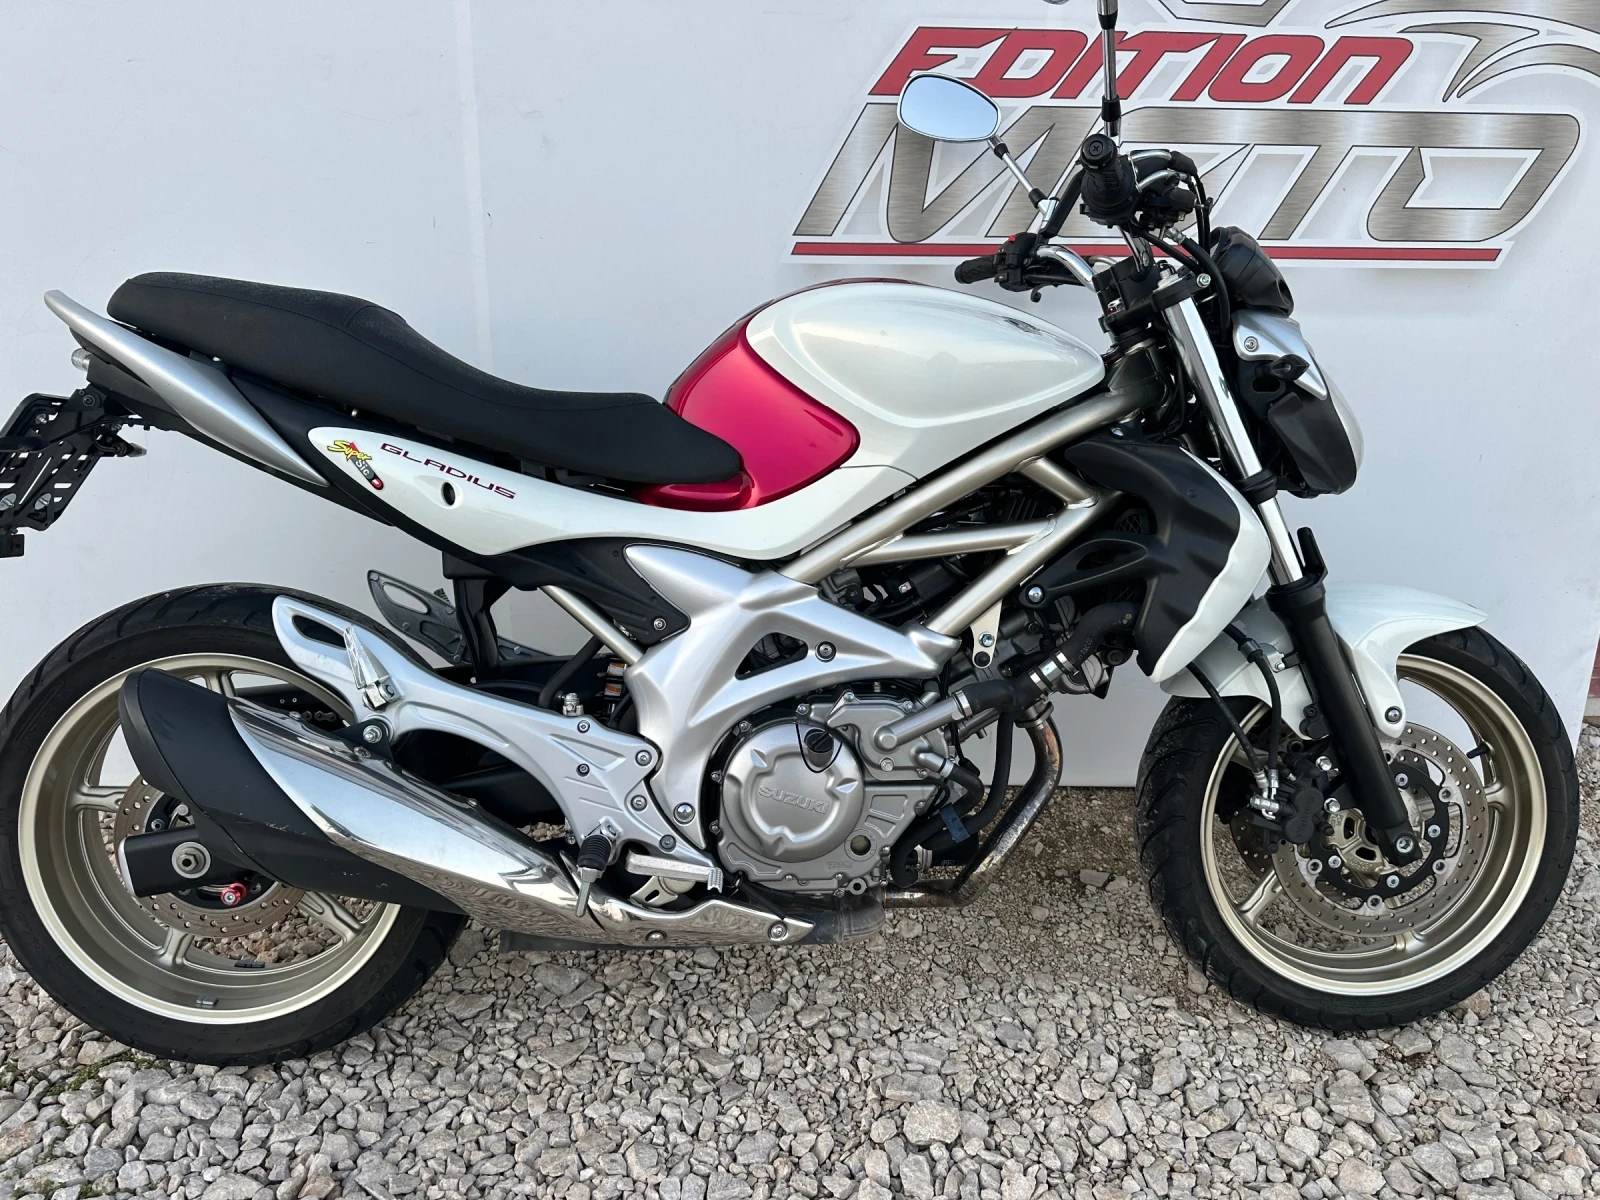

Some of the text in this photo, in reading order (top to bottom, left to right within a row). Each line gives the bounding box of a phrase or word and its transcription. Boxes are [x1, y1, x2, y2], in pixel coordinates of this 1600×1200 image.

[868, 27, 1413, 106] EDITION
[327, 440, 372, 461] Super
[380, 443, 516, 500] GLADIUS
[758, 784, 830, 815] SUZUKI
